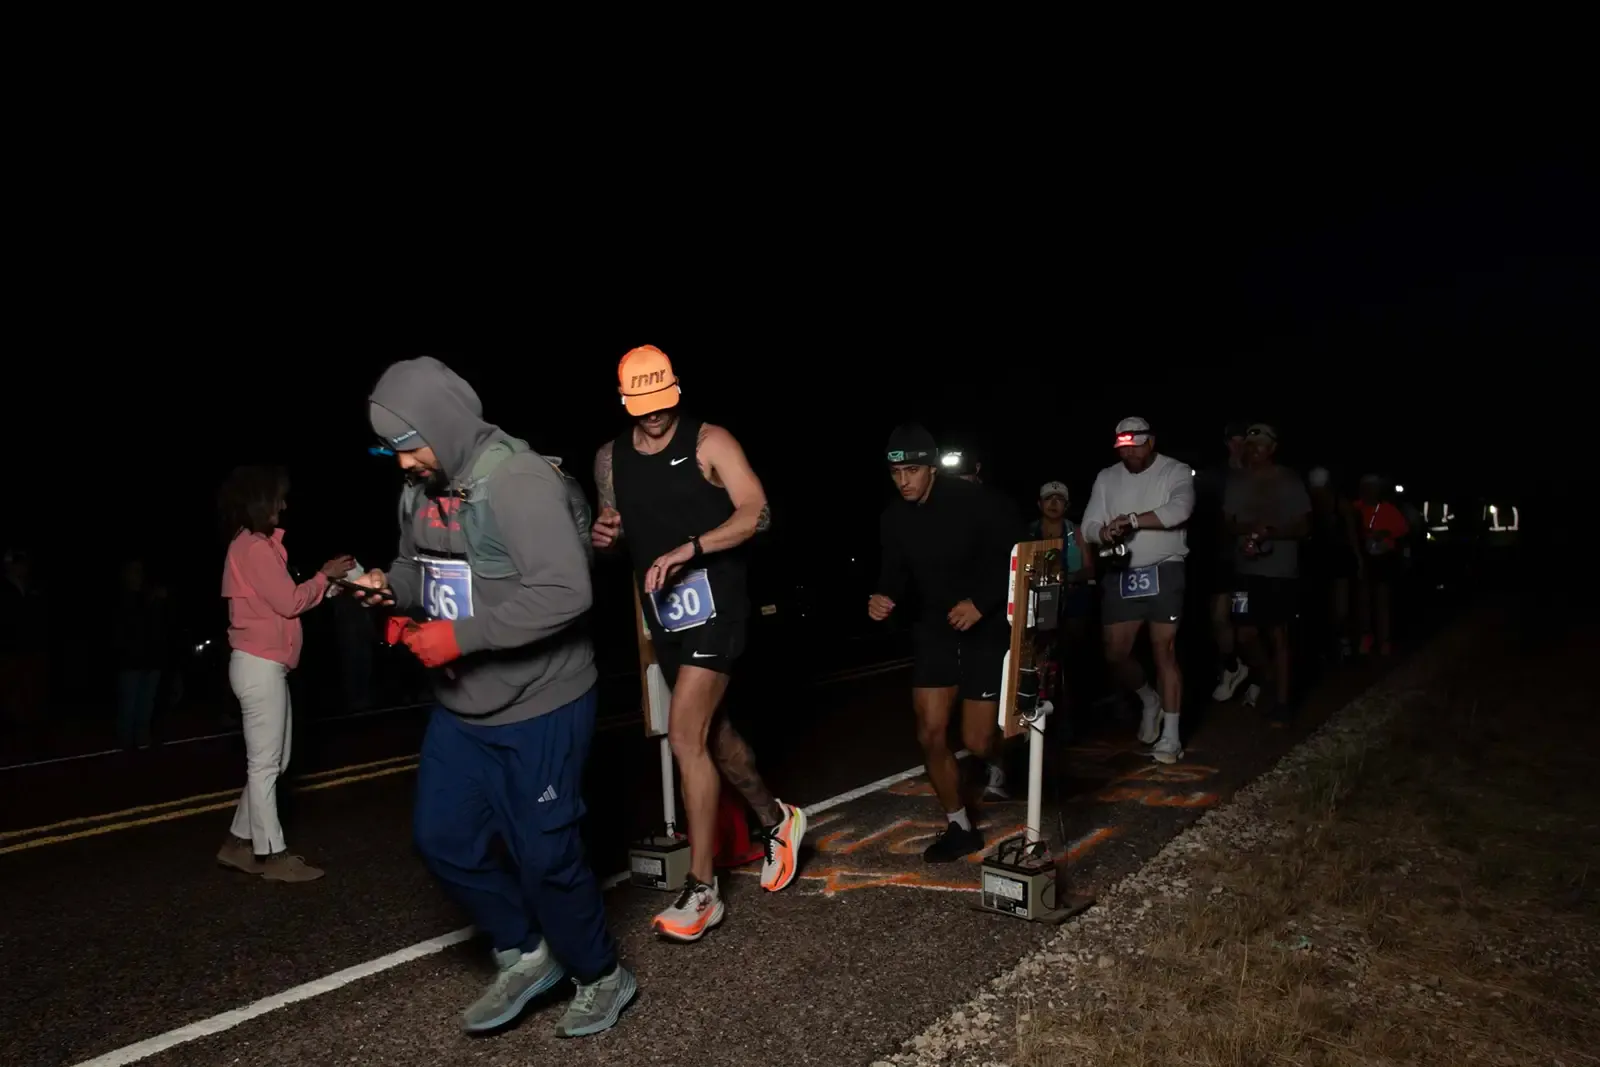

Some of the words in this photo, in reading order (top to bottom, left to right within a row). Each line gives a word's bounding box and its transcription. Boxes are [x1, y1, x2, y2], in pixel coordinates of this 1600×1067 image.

[1128, 573, 1150, 591] 35
[429, 580, 458, 620] 96
[667, 587, 701, 620] 30
